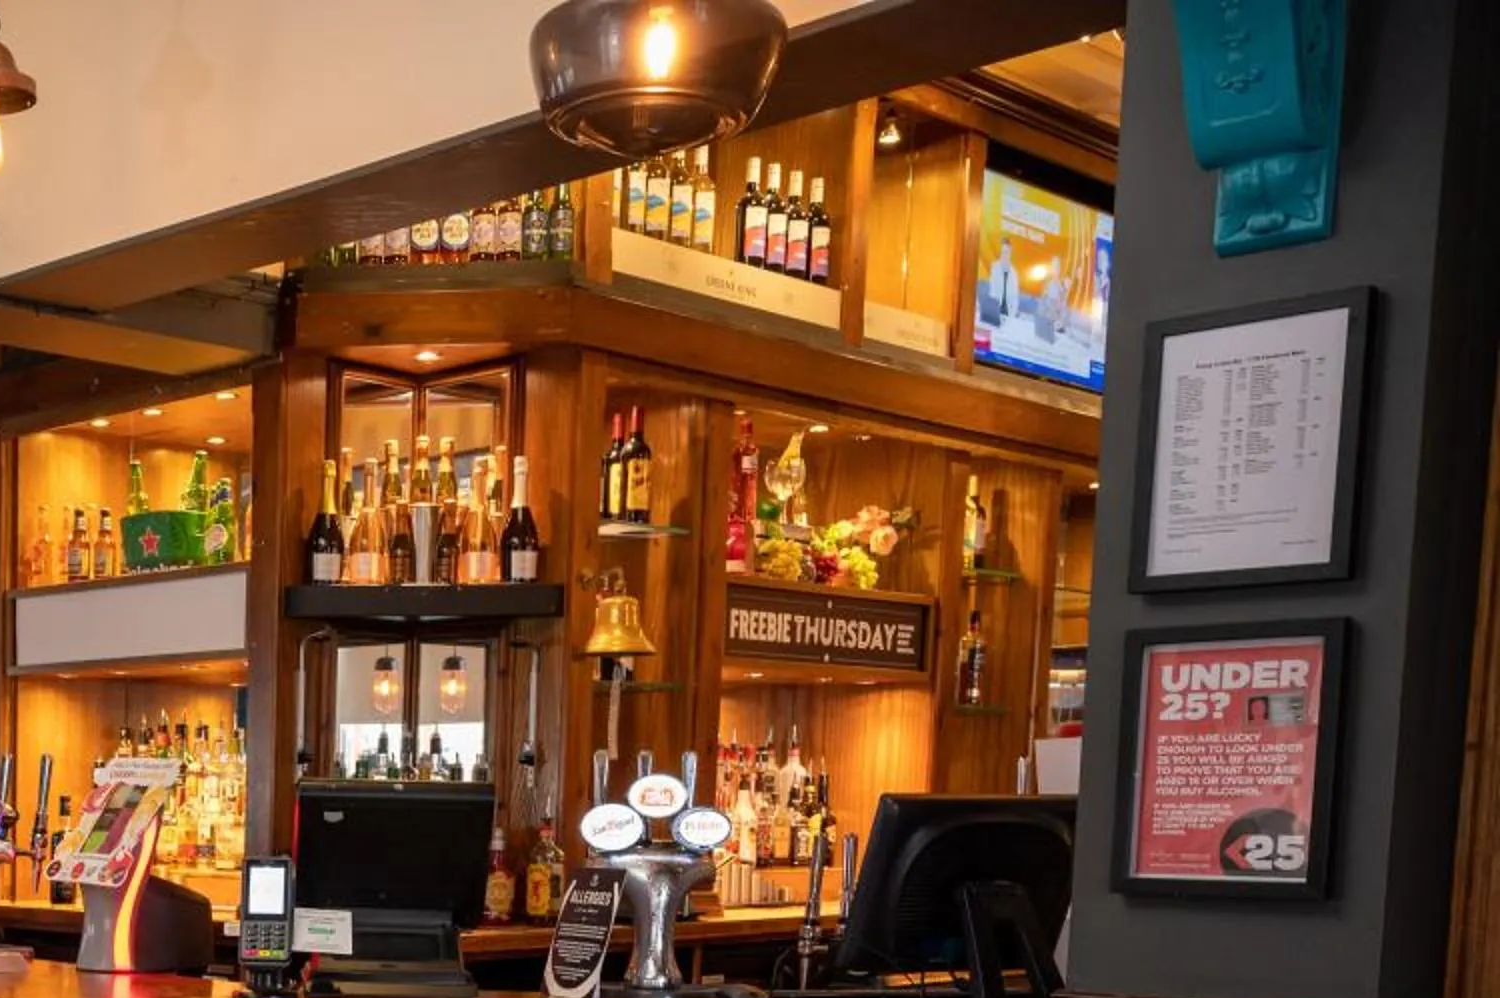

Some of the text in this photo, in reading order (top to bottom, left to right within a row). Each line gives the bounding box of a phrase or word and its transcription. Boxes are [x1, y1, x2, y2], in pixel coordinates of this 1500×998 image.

[729, 607, 897, 652] FREEBIE THURSDAY
[1161, 659, 1309, 692] UNDER
[1159, 692, 1231, 721] 25?
[1171, 735, 1195, 743] YOU
[1197, 734, 1220, 743] ARE
[1222, 733, 1262, 742] LUCKY
[1157, 743, 1304, 755] ENOUGH TO LOOK UNDER
[1172, 755, 1195, 765] YOU
[1199, 755, 1226, 765] WILL
[1247, 754, 1288, 764] ASKED
[1156, 766, 1171, 775] TO
[1173, 766, 1212, 775] PROVE
[1214, 765, 1244, 775] THAT
[1246, 765, 1272, 775] YOU
[1155, 776, 1187, 785] AGED
[1202, 776, 1219, 785] OR
[1221, 775, 1254, 785] OVER
[1256, 775, 1294, 785] WHEN
[1155, 787, 1178, 796] YOU
[1180, 787, 1204, 796] BUY
[1246, 834, 1305, 871] 25
[569, 889, 613, 906] ALLERGIES
